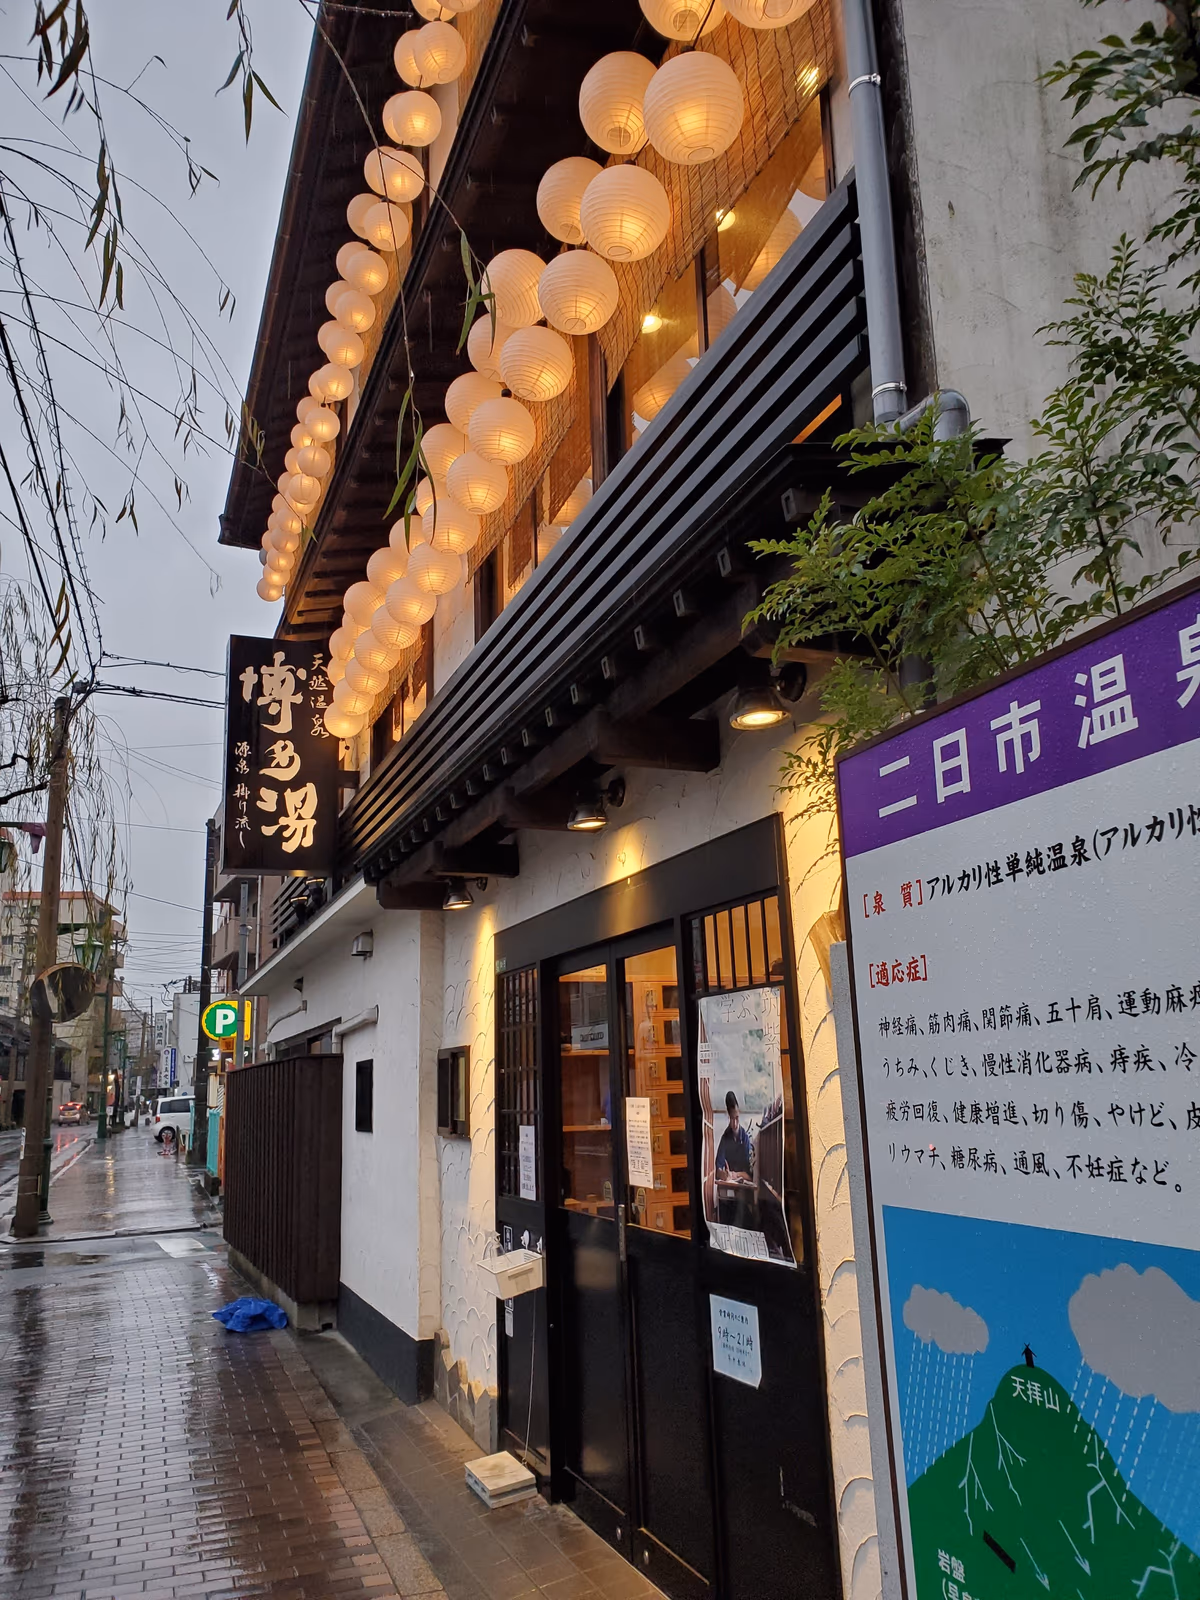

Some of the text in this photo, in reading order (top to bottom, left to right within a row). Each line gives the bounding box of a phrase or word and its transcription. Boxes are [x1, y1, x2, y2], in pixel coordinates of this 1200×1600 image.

[308, 653, 329, 738] 天然温泉
[239, 651, 318, 853] 博多湯
[215, 1008, 235, 1034] P
[1010, 1375, 1060, 1413] 天拝山
